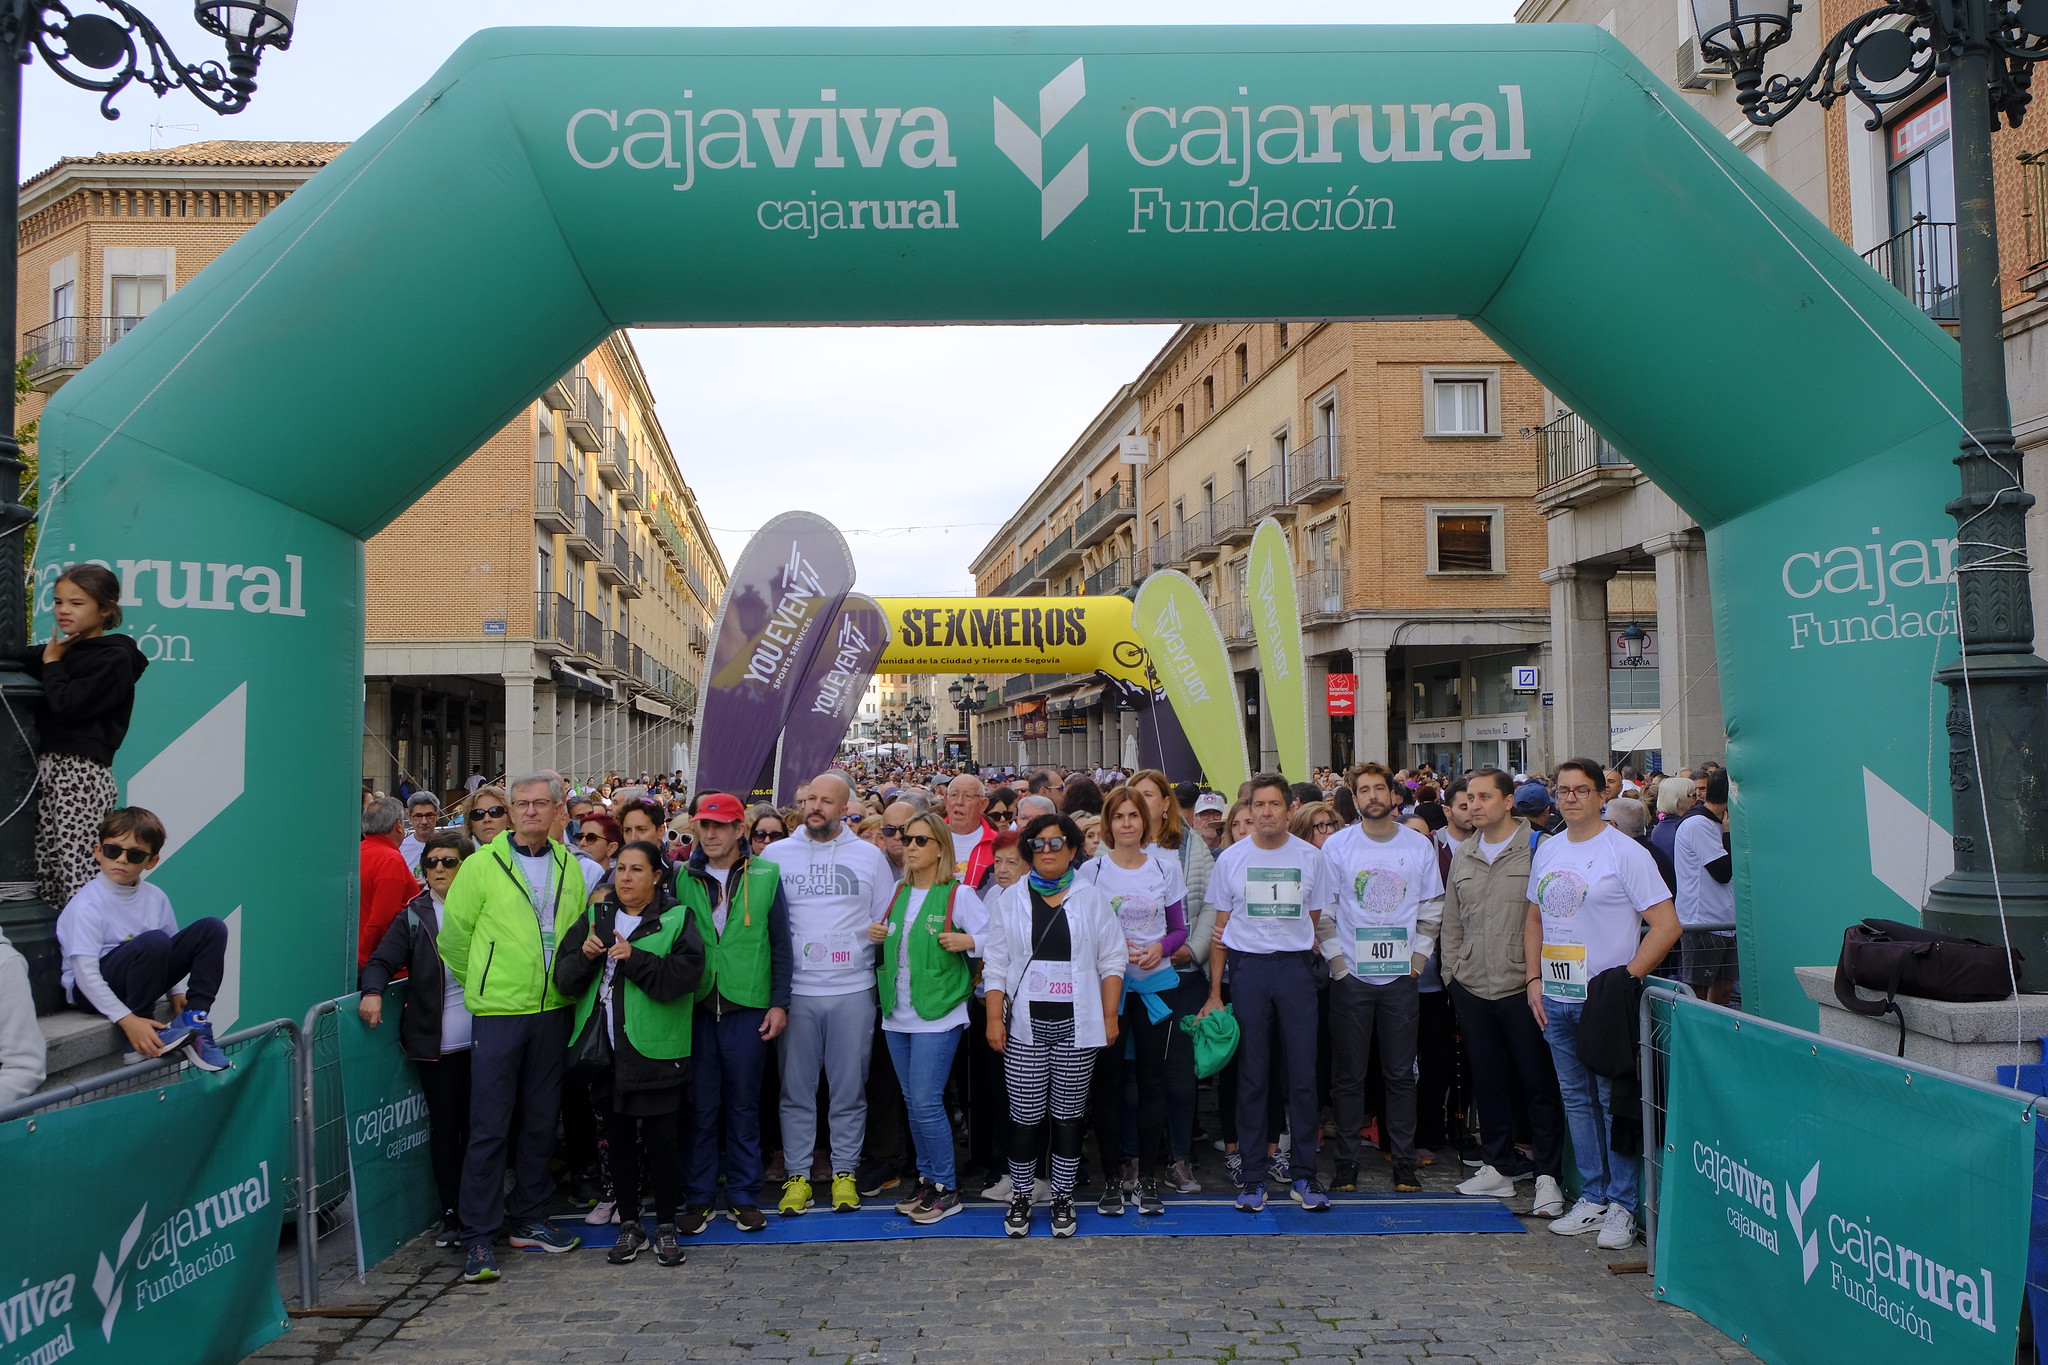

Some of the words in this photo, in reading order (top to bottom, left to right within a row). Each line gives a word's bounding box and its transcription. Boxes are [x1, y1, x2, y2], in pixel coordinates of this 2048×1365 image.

[566, 88, 957, 192] cajaviva
[1125, 84, 1531, 188] cajarural
[1896, 97, 1949, 155] CCO
[757, 190, 959, 239] cajarural
[1128, 185, 1397, 233] Fundación
[900, 606, 1087, 651] SEXMEROS
[773, 657, 793, 690] SPORTS
[790, 617, 813, 656] SERVICES
[1025, 657, 1060, 665] Segovia
[833, 694, 847, 719] SPORTS
[798, 885, 833, 896] FACE
[1271, 883, 1278, 901] 1
[831, 951, 851, 962] 1901
[1371, 942, 1394, 959] 407
[1550, 961, 1570, 980] 1117
[1049, 982, 1073, 995] 2335
[1693, 1140, 1777, 1220] cajaviva
[136, 1160, 270, 1270] cajarural
[1726, 1207, 1780, 1256] cajarural
[136, 1242, 236, 1311] Fundación
[1827, 1214, 1996, 1333] cajarural
[1830, 1261, 1934, 1345] Fundación
